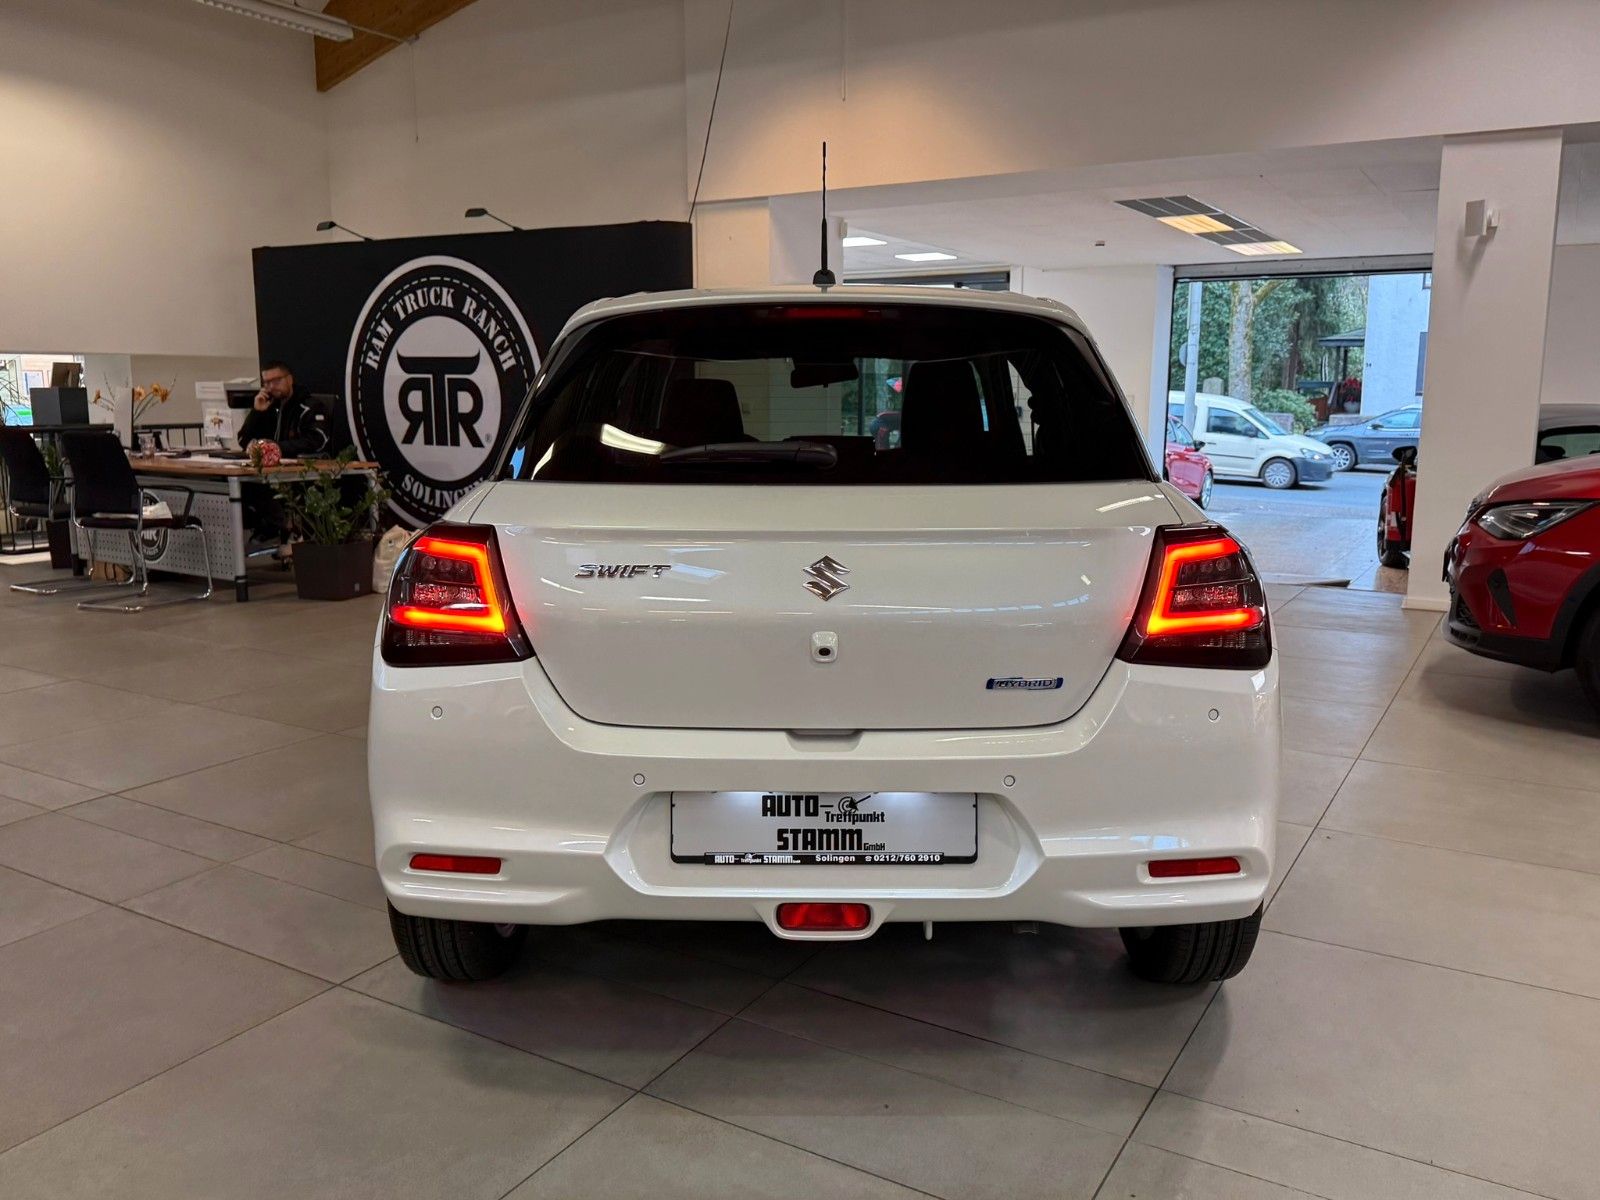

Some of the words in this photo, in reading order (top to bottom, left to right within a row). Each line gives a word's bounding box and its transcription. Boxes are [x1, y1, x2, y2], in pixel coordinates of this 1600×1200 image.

[365, 319, 394, 371] RAM
[392, 286, 455, 321] TRUCK
[462, 295, 518, 373] RANCH
[574, 563, 672, 579] SWIFT
[824, 810, 886, 825] Treffpunkt
[776, 828, 863, 851] STAMM
[863, 842, 886, 851] GmbH
[763, 855, 793, 864] STAMM
[815, 854, 856, 864] Solingen
[873, 854, 916, 863] 0212/760
[917, 854, 941, 863] 2910
